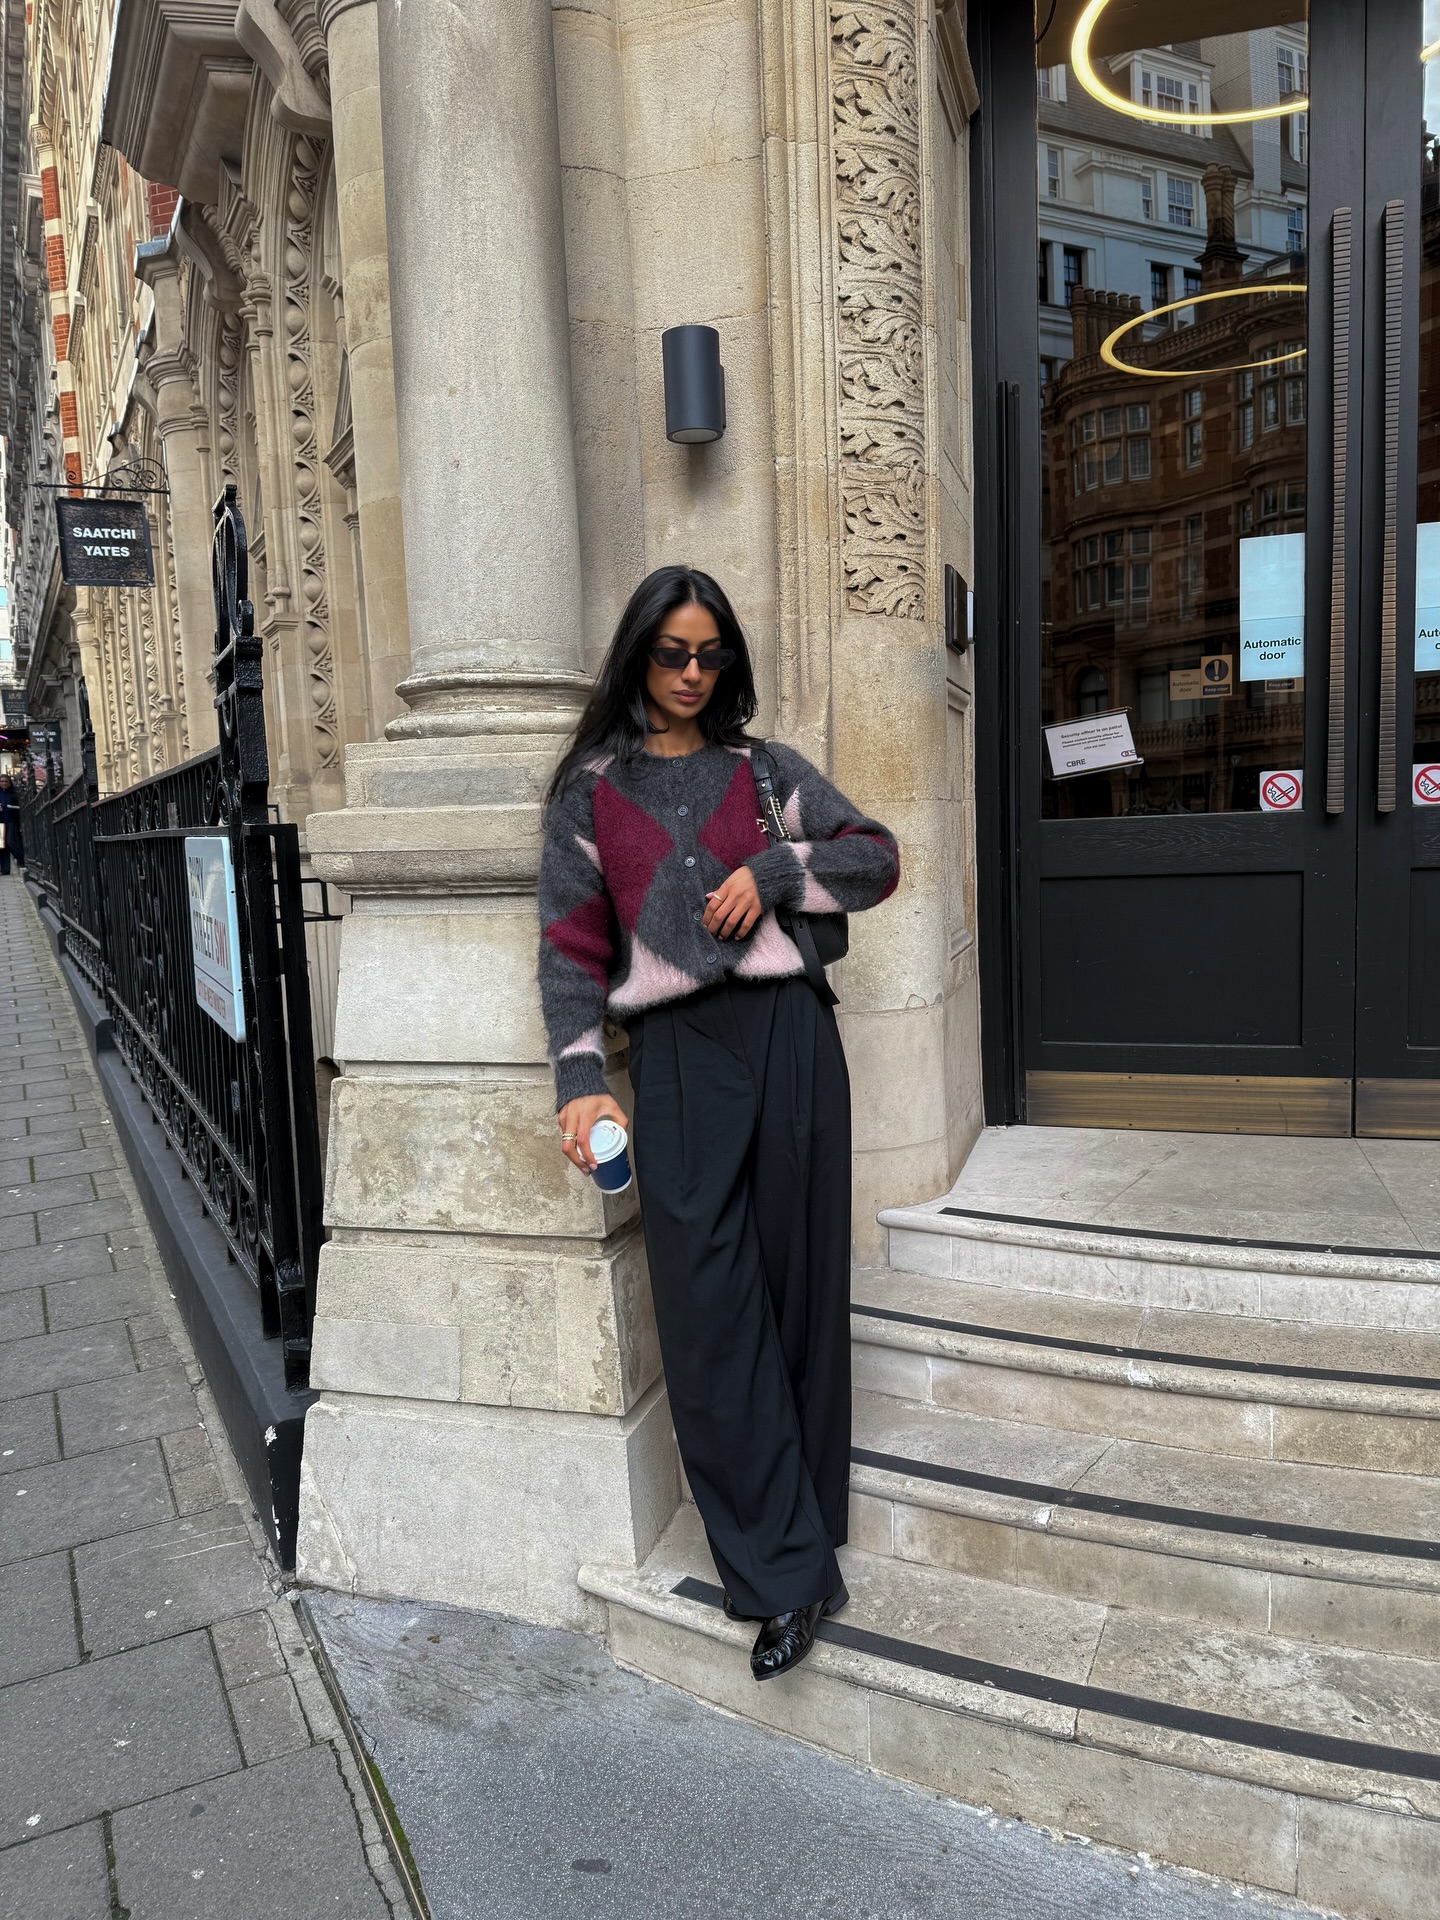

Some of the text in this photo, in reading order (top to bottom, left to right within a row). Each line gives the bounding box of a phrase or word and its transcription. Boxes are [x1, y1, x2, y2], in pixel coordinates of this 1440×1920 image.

[72, 527, 136, 539] SAATCHI
[83, 545, 130, 557] YATES
[1243, 636, 1302, 649] Automatic
[1259, 651, 1286, 660] door
[1066, 759, 1086, 768] CBRE
[193, 909, 214, 961] STREET
